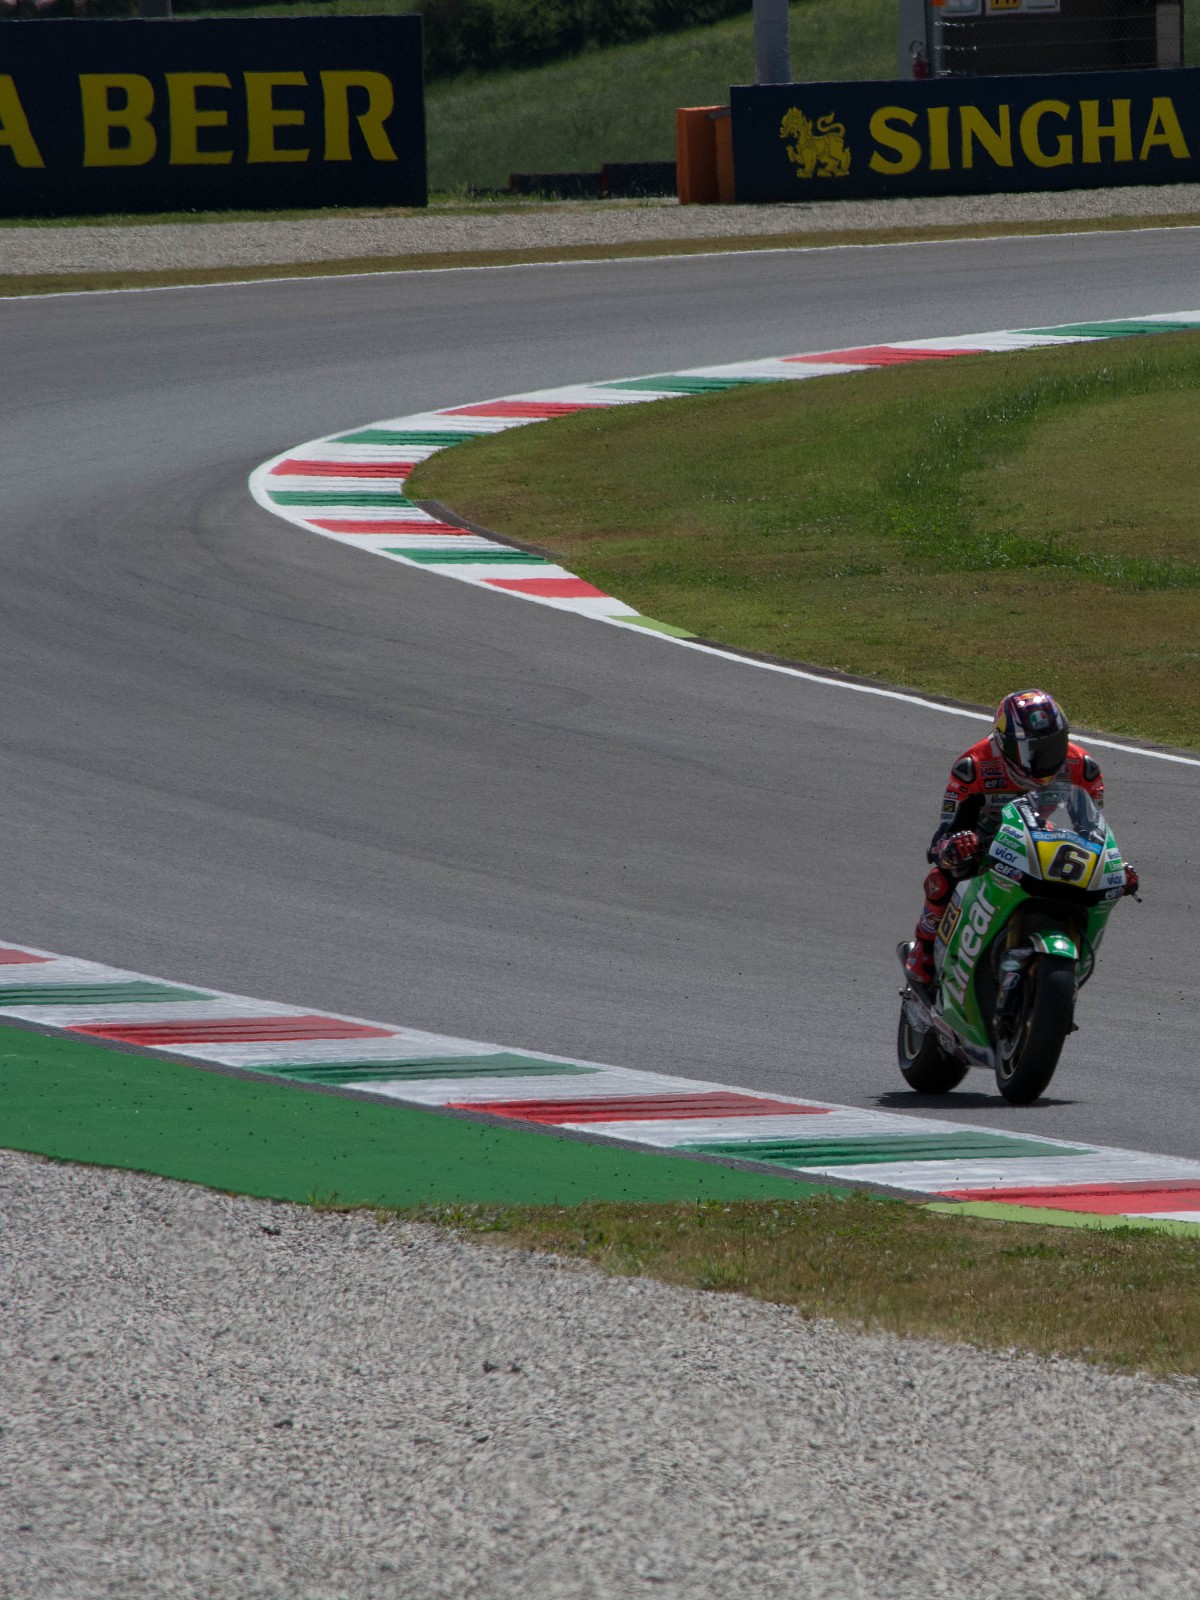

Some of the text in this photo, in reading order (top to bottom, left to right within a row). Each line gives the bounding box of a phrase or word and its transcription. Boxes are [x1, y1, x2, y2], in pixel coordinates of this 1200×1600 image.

[80, 70, 397, 166] BEER
[869, 98, 1189, 175] SINGHA
[994, 863, 1013, 875] elf
[995, 846, 1018, 862] viar
[1048, 844, 1092, 882] 6
[946, 884, 997, 1006] Linear
